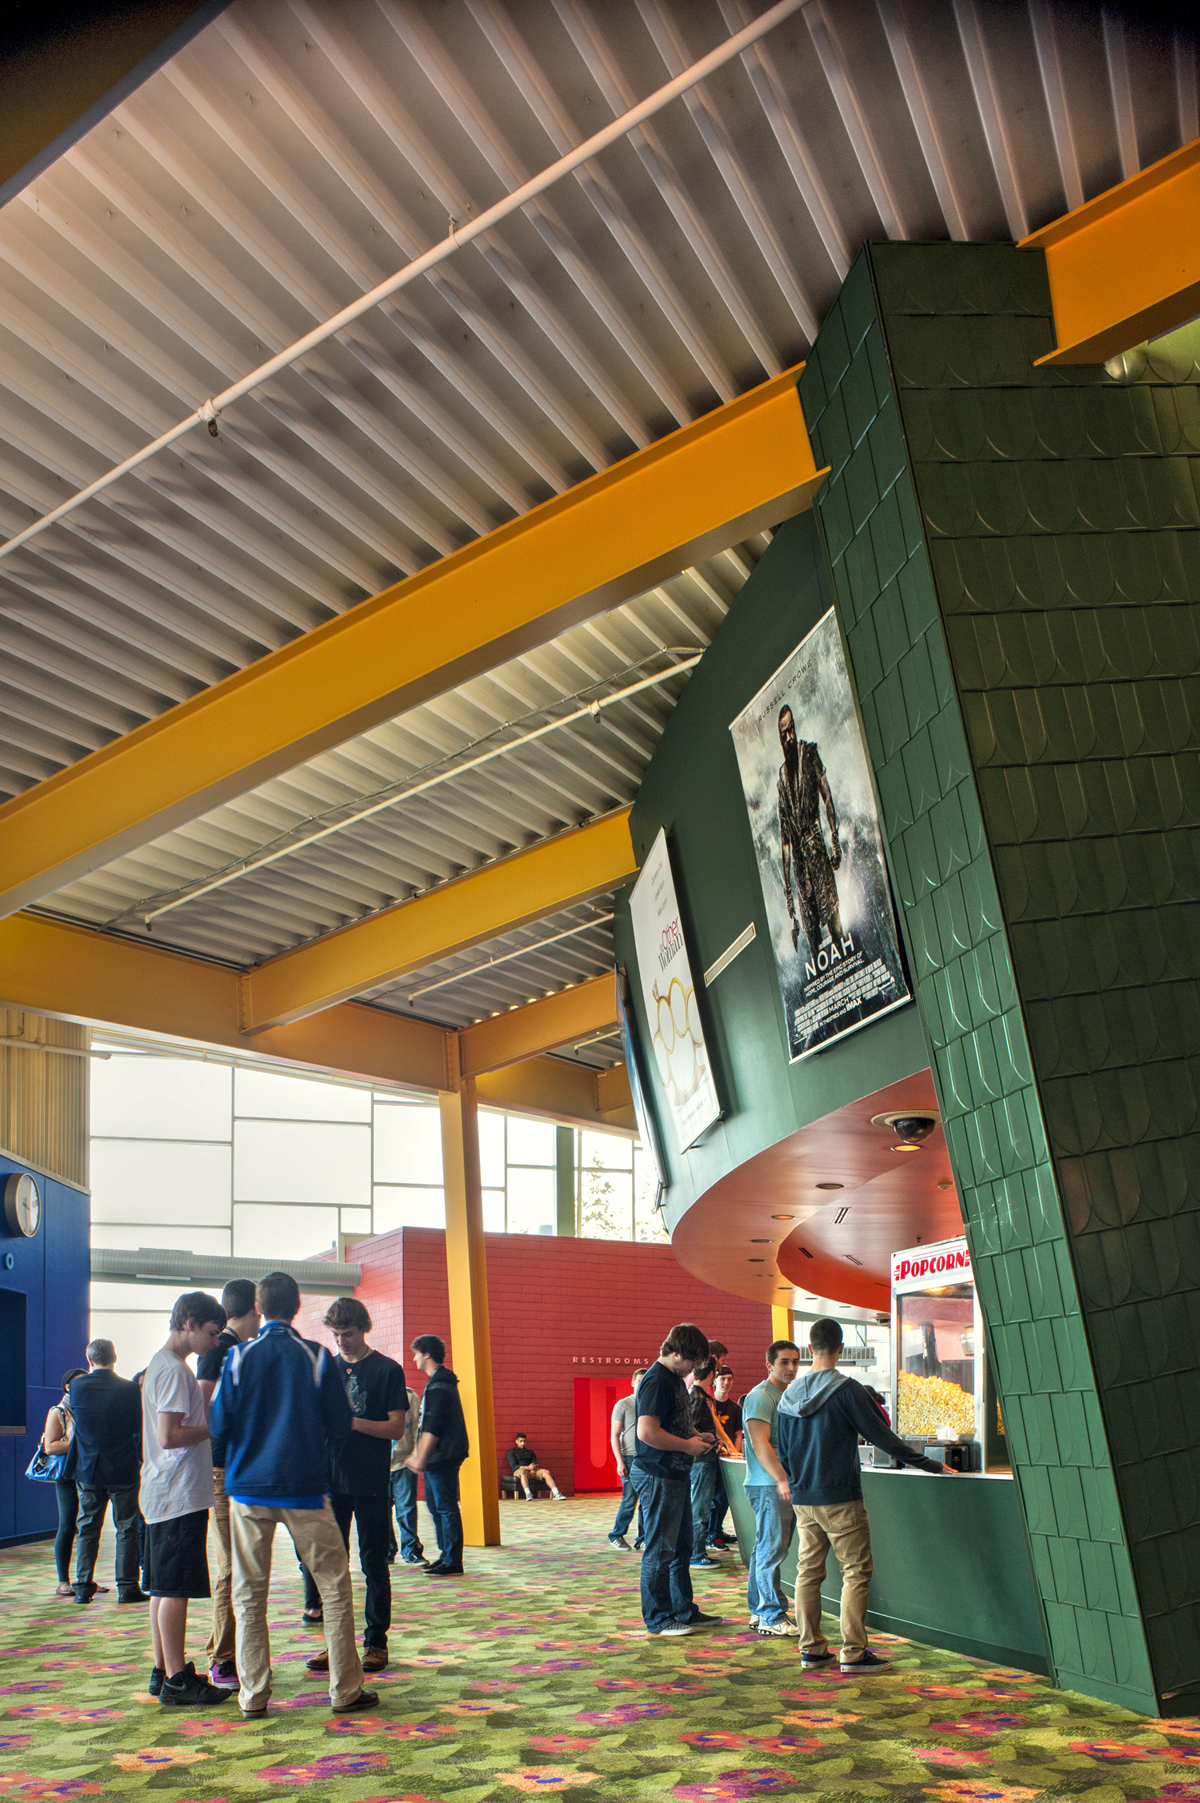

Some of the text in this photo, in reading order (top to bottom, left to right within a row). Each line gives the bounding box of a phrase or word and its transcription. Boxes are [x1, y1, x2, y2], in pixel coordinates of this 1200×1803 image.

[758, 659, 812, 723] RUSSELL CROWE
[661, 916, 679, 950] Other
[805, 932, 855, 980] NOAH
[842, 954, 856, 967] STORY
[856, 950, 863, 959] OF
[834, 969, 843, 979] AND
[828, 995, 849, 1013] MARCH
[845, 995, 862, 1011] IMAX
[900, 1251, 965, 1280] POPCORN
[572, 1356, 649, 1365] RESTROOMS
